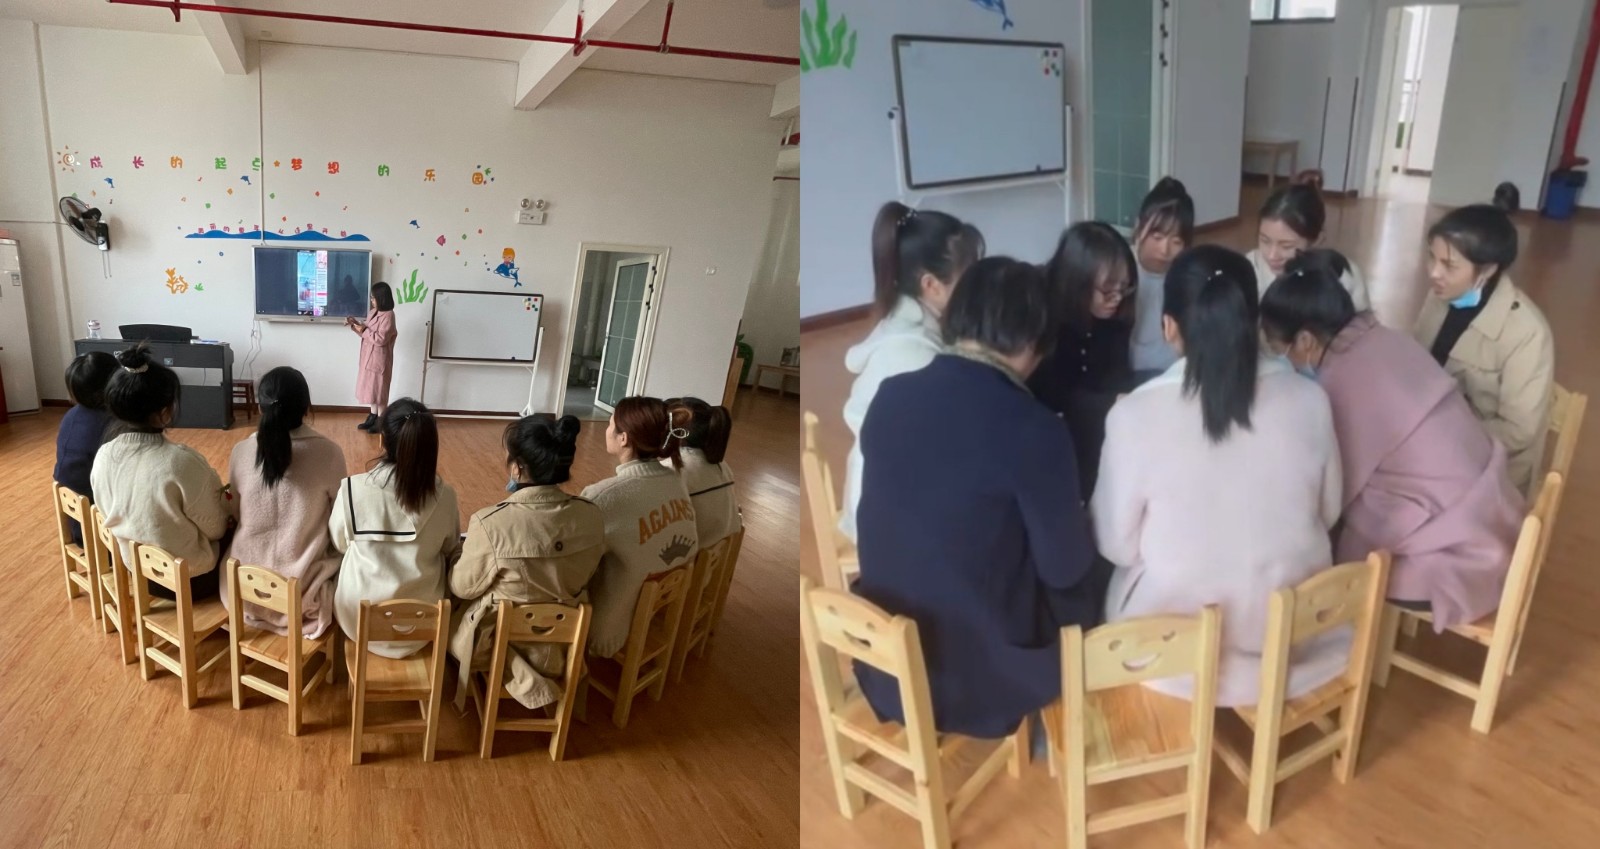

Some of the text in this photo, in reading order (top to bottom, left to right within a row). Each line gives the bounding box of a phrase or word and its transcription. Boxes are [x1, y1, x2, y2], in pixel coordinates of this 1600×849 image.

[290, 157, 484, 186] 梦想的乐园
